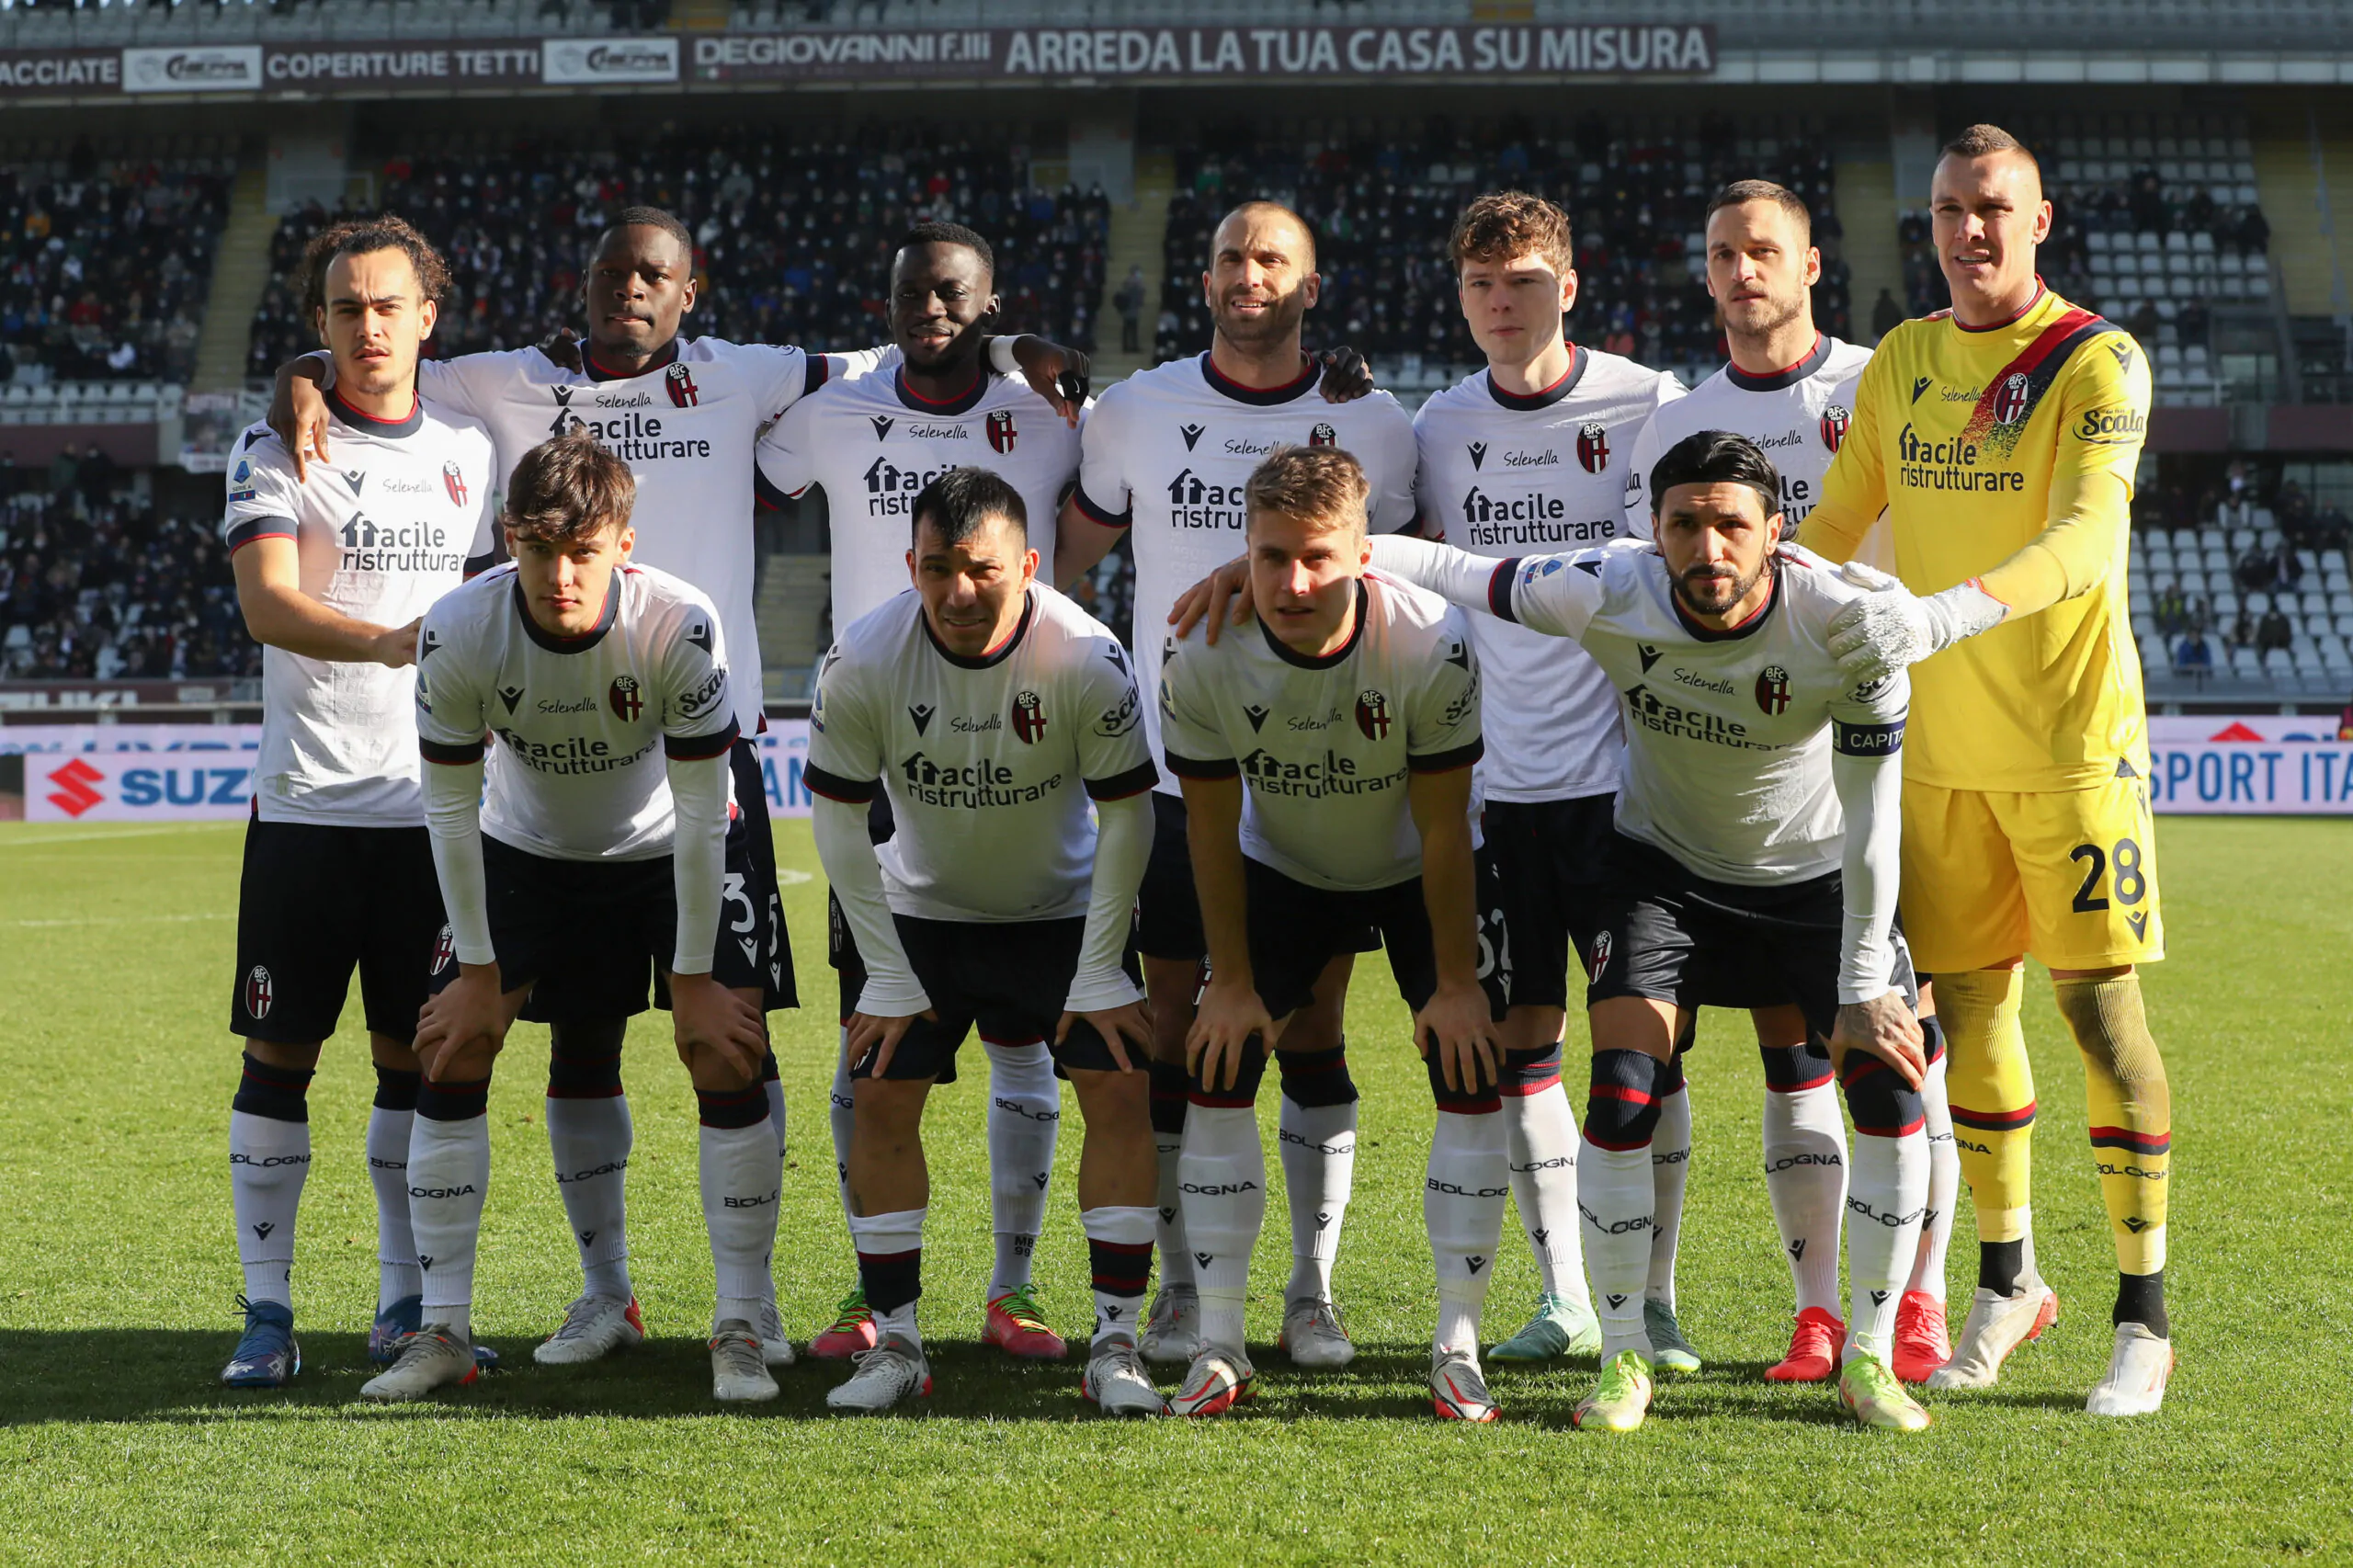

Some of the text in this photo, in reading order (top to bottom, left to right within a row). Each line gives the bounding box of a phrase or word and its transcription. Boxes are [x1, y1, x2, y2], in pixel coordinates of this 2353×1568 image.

[695, 34, 934, 65] DEGIOVANNI
[1006, 27, 1711, 74] ARREDA LA TUA CASA SU MISURA
[267, 49, 449, 79] COPERTURE
[454, 47, 539, 75] TETTI
[668, 364, 686, 377] BFC
[2007, 374, 2024, 385] BFC
[596, 391, 653, 409] Selenella
[1827, 405, 1845, 417] BFC
[909, 424, 969, 440] Selenella
[1316, 424, 1332, 436] BFC
[1584, 424, 1601, 436] BFC
[2082, 408, 2144, 437] Scala
[1899, 422, 1976, 466] facile
[1504, 449, 1560, 467] Selenella
[382, 478, 434, 493] Selenella
[1901, 463, 2025, 492] ristrutturare
[1462, 485, 1564, 522] facile
[340, 510, 446, 548] facile
[1470, 519, 1615, 545] ristrutturare
[343, 549, 466, 572] ristrutturar
[617, 677, 636, 687] BFC
[1673, 666, 1737, 697] Selenella
[1766, 667, 1784, 678] BFC
[537, 697, 598, 715] Selenella
[1018, 692, 1036, 705] BFC
[1362, 691, 1381, 703] BFC
[1624, 683, 1746, 737] facile
[901, 750, 1013, 788] facile
[120, 767, 256, 806] SUZ
[908, 773, 1063, 811] ristrutturare
[2068, 837, 2146, 914] 28
[254, 967, 267, 980] BFC
